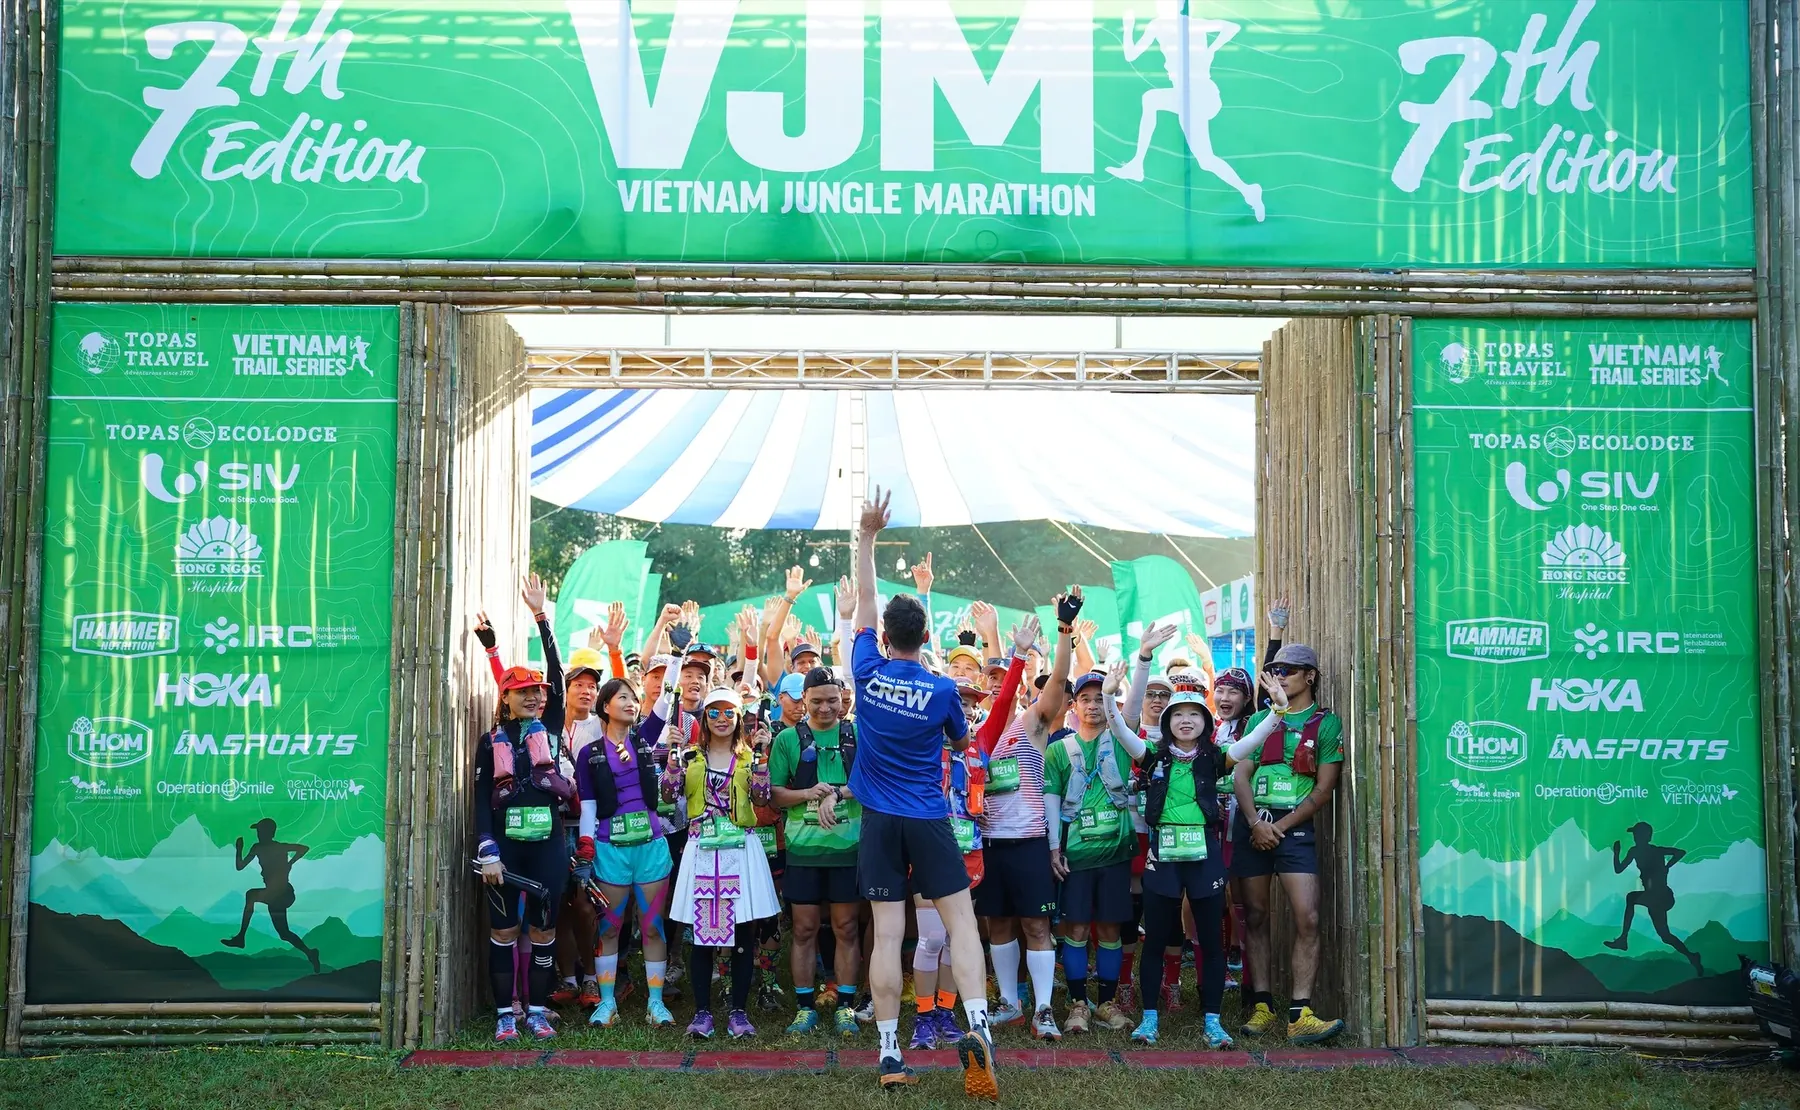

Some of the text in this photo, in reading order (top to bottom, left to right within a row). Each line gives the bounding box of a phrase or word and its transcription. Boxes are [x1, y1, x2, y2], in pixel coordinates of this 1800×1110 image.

[130, 0, 353, 179] 7th
[566, 0, 1095, 174] VJM
[1391, 0, 1599, 192] 7th
[202, 112, 427, 184] Edition
[1459, 124, 1677, 195] Edition
[617, 180, 1096, 217] VIETNAM JUNGLE MARATHON
[124, 331, 197, 348] TOPAS
[232, 334, 347, 356] VIETNAM
[124, 350, 209, 367] TRAVEL
[1484, 342, 1554, 358] TOPAS
[1588, 344, 1701, 366] VIETNAM
[232, 357, 347, 377] TRAIL SERIES
[1484, 361, 1567, 377] TRAVEL
[1589, 367, 1702, 386] TRAIL SERIES
[106, 424, 337, 442] TOPAS ECOLODGE
[1469, 433, 1694, 451] TOPAS ECOLODGE
[218, 463, 300, 491] SIV
[1580, 472, 1660, 499] SIV
[218, 495, 236, 503] One
[237, 496, 258, 505] Step.
[278, 496, 300, 504] Goal.
[1581, 503, 1598, 511] One
[1600, 503, 1620, 512] Step.
[175, 562, 261, 575] HONG NGOC
[1542, 570, 1627, 581] HONG NGOC
[187, 580, 248, 598] Hospital
[1555, 586, 1615, 604] Hospital
[79, 619, 173, 641] HAMMER
[248, 625, 313, 648] IRC
[1453, 626, 1543, 646] HAMMER
[1474, 645, 1527, 657] NUTRITION
[1616, 631, 1680, 654] IRC
[154, 673, 273, 707] HOKA
[865, 677, 933, 712] CREW
[1526, 678, 1645, 712] HOKA
[876, 702, 898, 714] JUNGLE
[897, 708, 929, 721] MOUNTAIN
[113, 785, 142, 798] dragon
[156, 781, 275, 796] Operation Smile
[287, 778, 349, 789] newborns
[1273, 781, 1292, 791] 2500
[1535, 784, 1649, 800] Operation Smile
[1661, 783, 1722, 793] newborns
[287, 789, 349, 801] VIETNAM
[1493, 788, 1521, 799] dragon
[1662, 793, 1722, 805] VIETNAM
[1180, 832, 1202, 841] F2103
[877, 887, 889, 897] T8
[1047, 902, 1056, 910] T8
